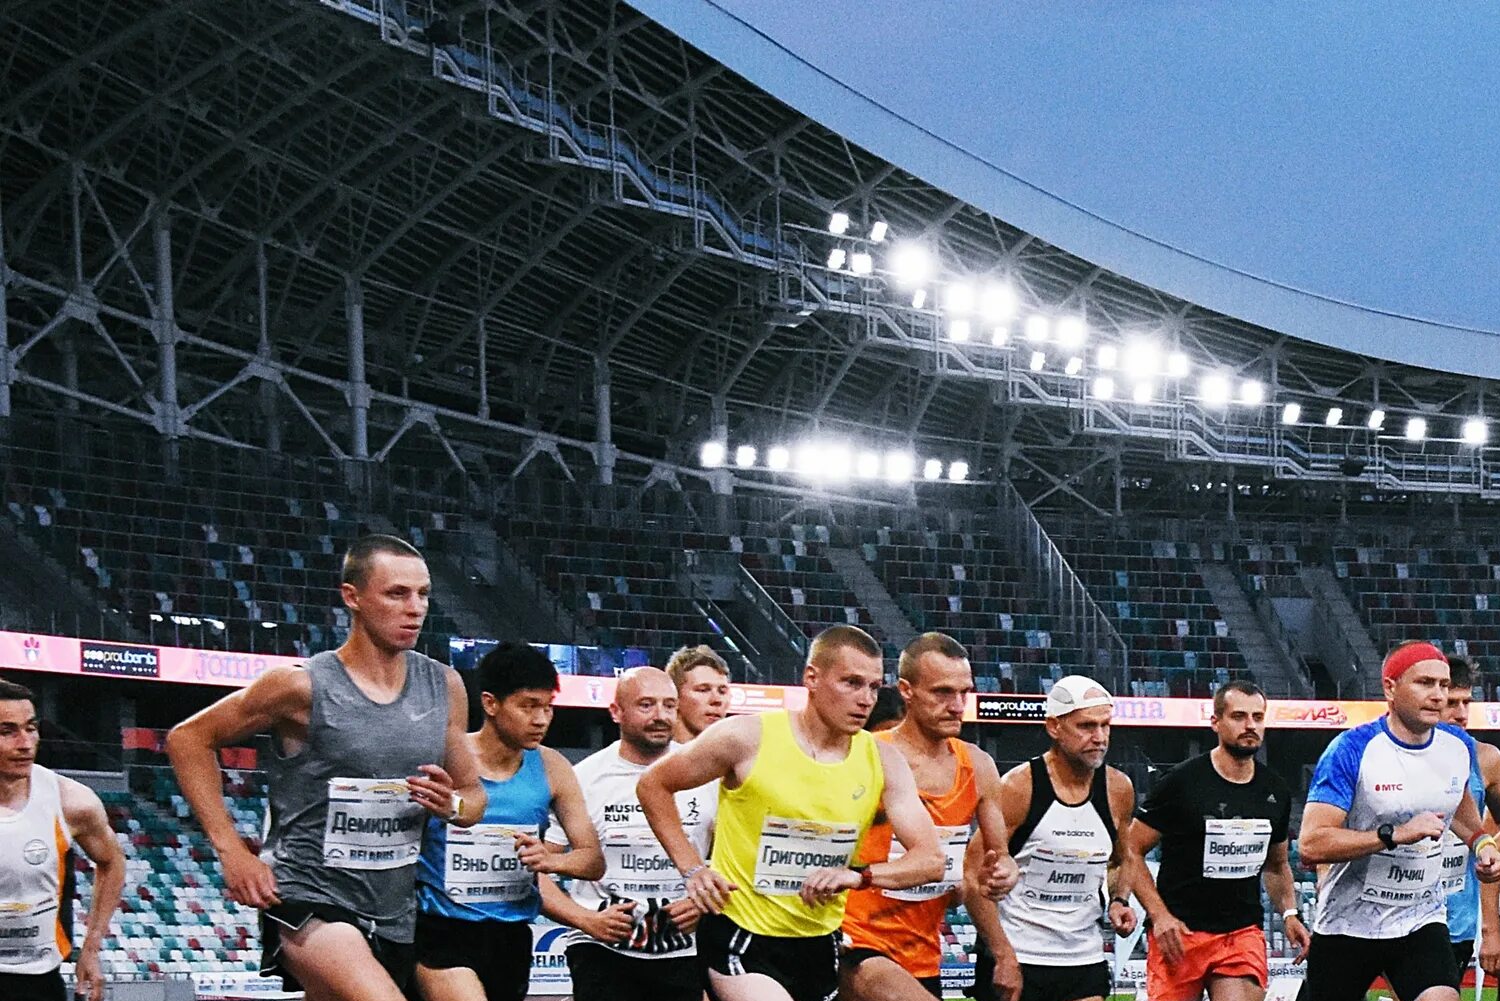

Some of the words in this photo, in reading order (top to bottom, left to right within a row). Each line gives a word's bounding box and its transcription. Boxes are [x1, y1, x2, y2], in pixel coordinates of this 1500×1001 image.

[604, 804, 643, 813] MUSIC
[604, 814, 630, 822] RUN
[350, 849, 395, 860] BELARUS
[1209, 841, 1264, 857] Вербицкий
[452, 853, 489, 872] Вэнь
[763, 845, 848, 869] Григорович
[1047, 869, 1086, 884] Антип
[624, 883, 660, 892] BELARUS
